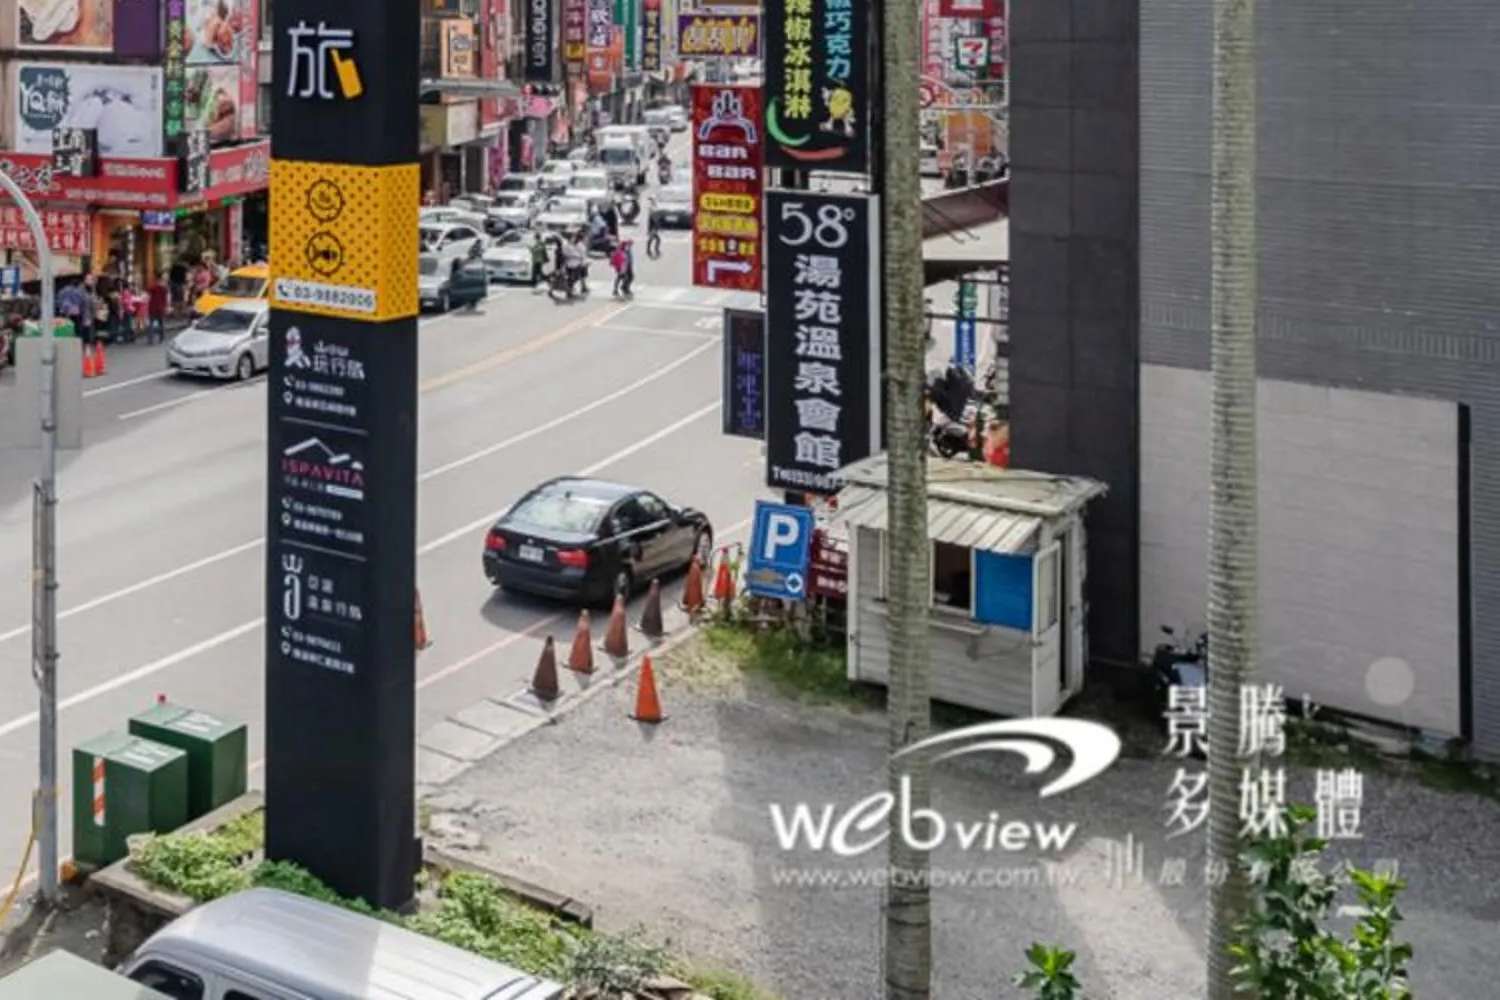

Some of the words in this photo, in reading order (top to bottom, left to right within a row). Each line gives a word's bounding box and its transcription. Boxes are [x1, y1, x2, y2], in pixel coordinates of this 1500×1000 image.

[778, 201, 855, 247] 58°
[794, 252, 842, 470] 湯苑溫泉會館
[763, 513, 798, 560] P
